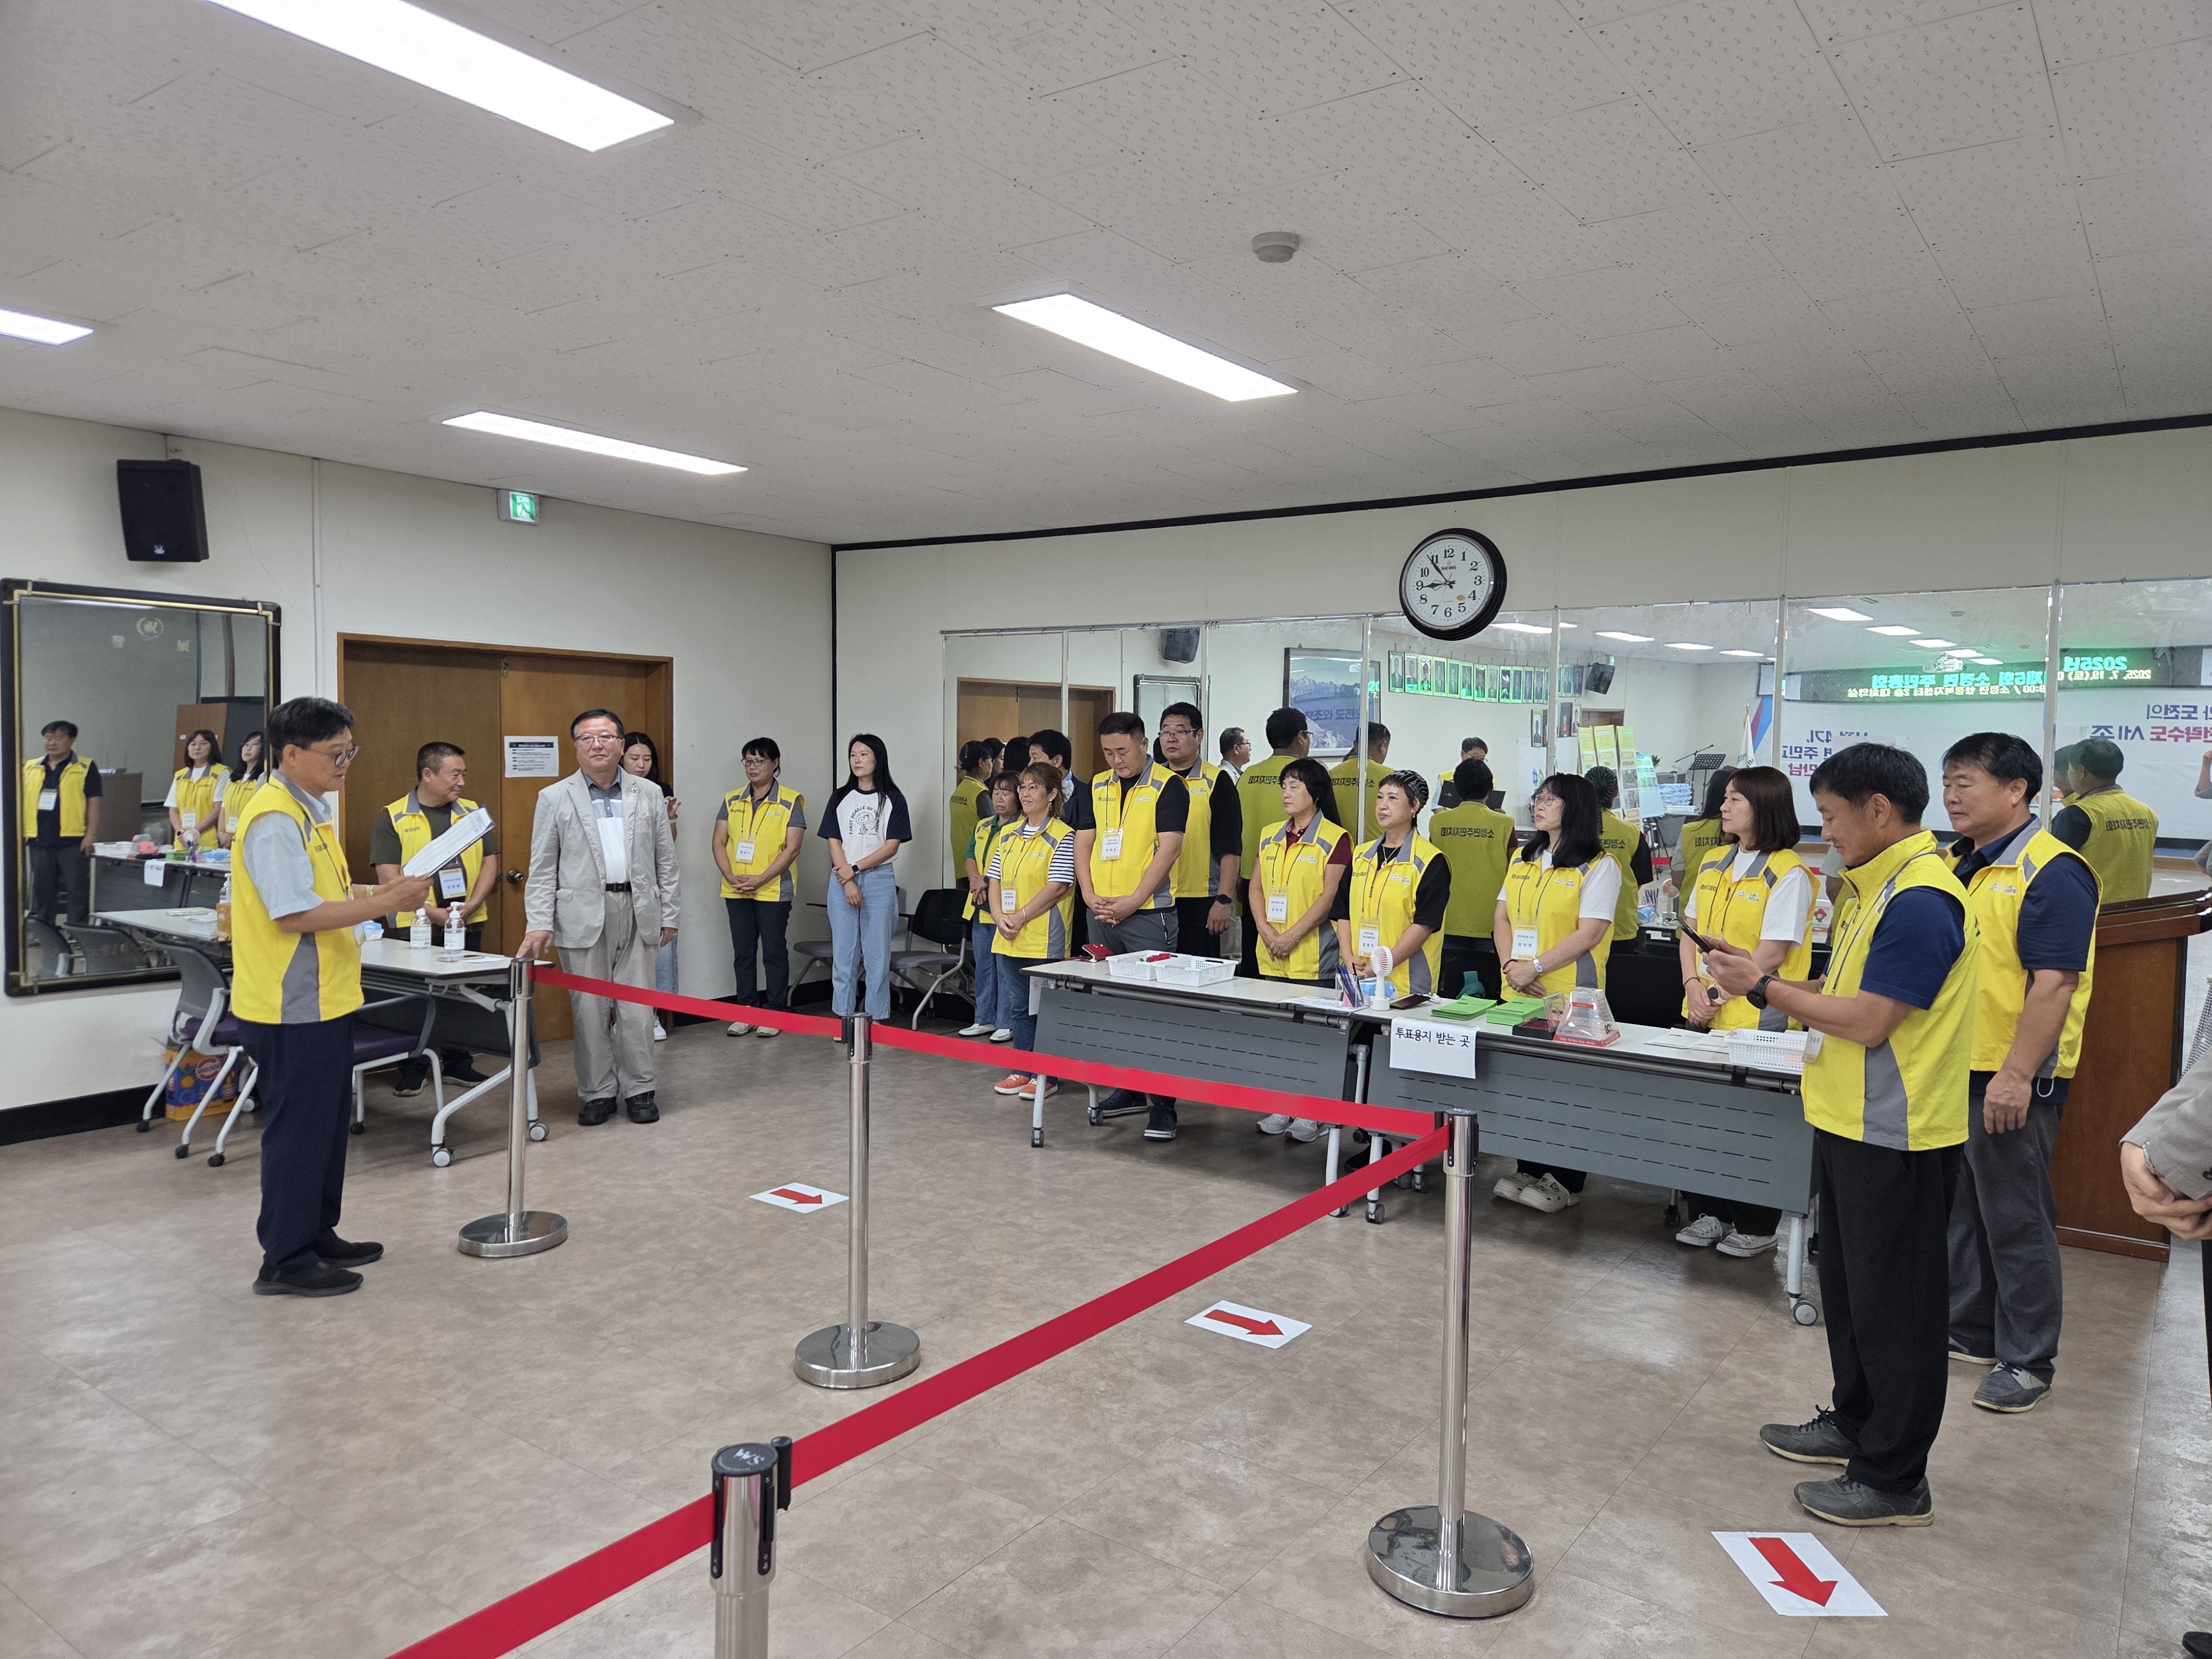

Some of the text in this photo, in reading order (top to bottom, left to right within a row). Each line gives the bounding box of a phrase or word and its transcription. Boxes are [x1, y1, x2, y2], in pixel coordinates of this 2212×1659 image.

[1444, 548, 1454, 558] 12
[1461, 551, 1466, 561] 1
[1470, 561, 1478, 571] 2
[1420, 567, 1430, 577] 10
[1416, 580, 1423, 590] 9
[1474, 575, 1482, 585] 3
[1420, 594, 1427, 604] 8
[1468, 590, 1477, 600] 4
[1431, 604, 1439, 614] 7
[1444, 607, 1452, 617] 6
[1458, 602, 1466, 612] 5
[1395, 1027, 1470, 1047] 투표용지 받는 곳
